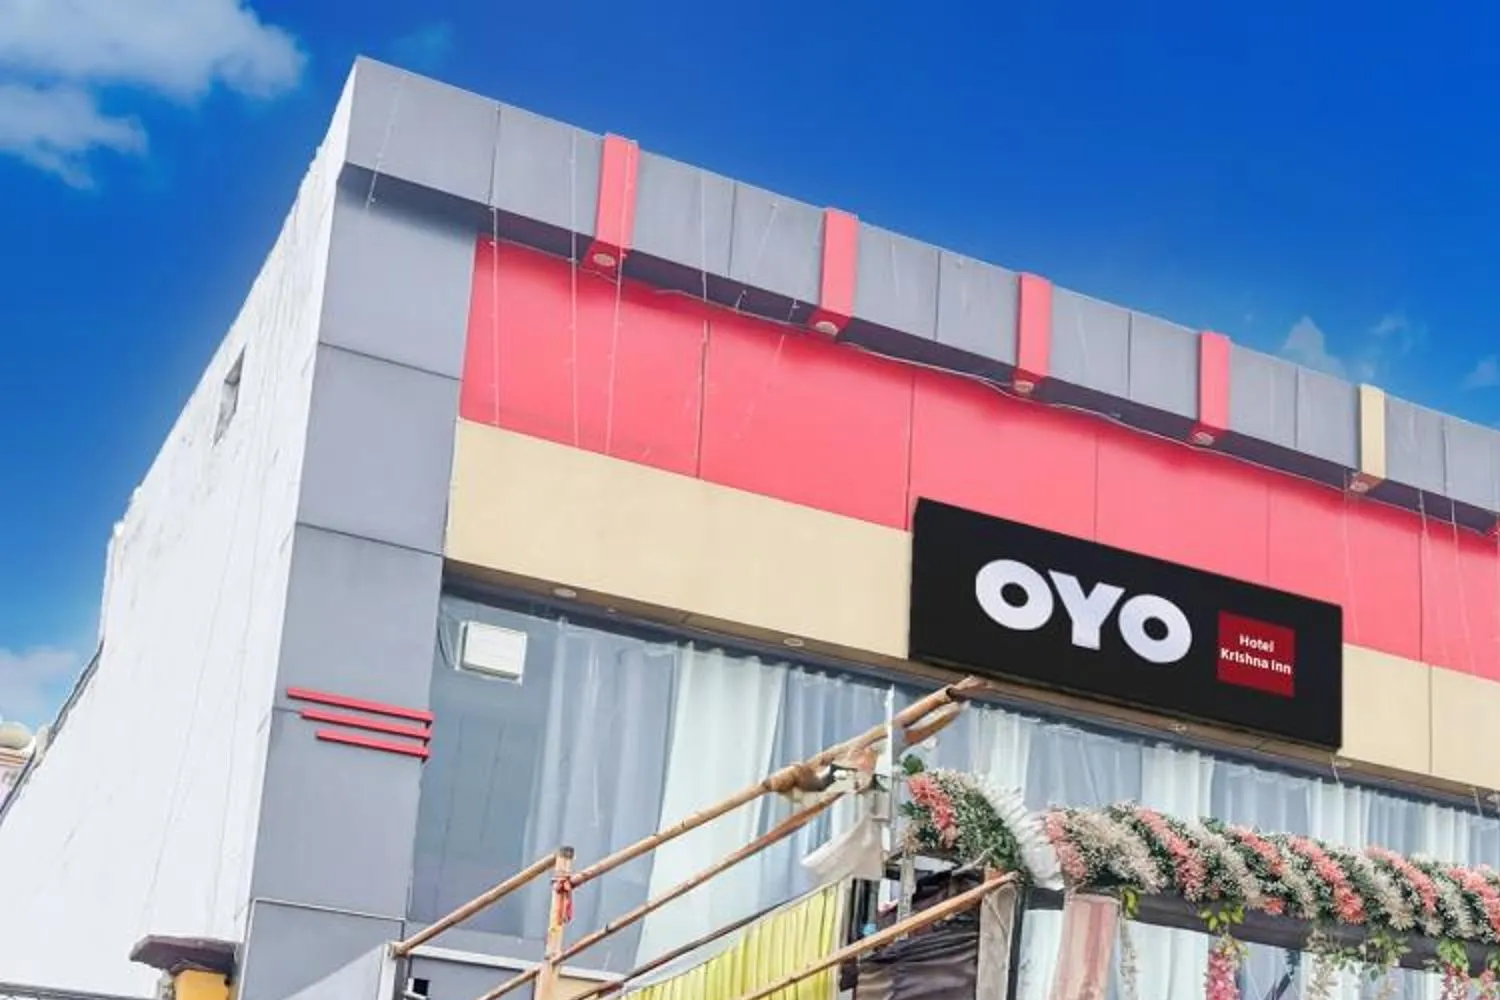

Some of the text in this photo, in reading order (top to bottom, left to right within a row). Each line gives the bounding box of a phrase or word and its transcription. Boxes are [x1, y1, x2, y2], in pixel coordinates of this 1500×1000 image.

[976, 559, 1192, 664] OYO
[1239, 633, 1275, 653] Hotel
[1220, 647, 1293, 675] Krishna Inn
